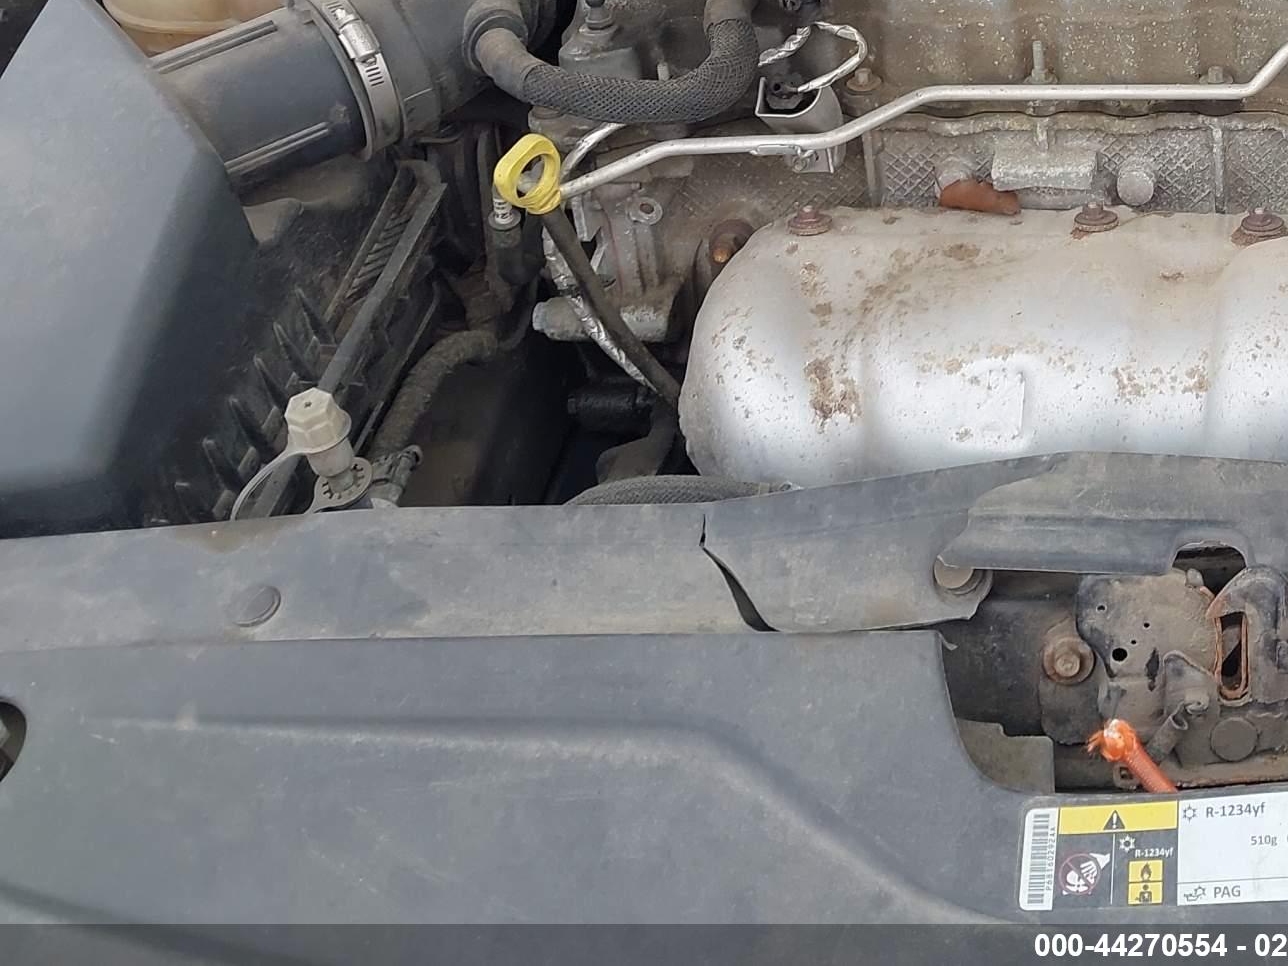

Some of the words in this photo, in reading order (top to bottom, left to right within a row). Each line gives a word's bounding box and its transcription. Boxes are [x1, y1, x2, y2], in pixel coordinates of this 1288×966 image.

[1205, 801, 1267, 818] R-1234yf
[1250, 834, 1278, 846] 510g
[1134, 847, 1175, 858] R-1234yf
[1213, 885, 1241, 898] PAG
